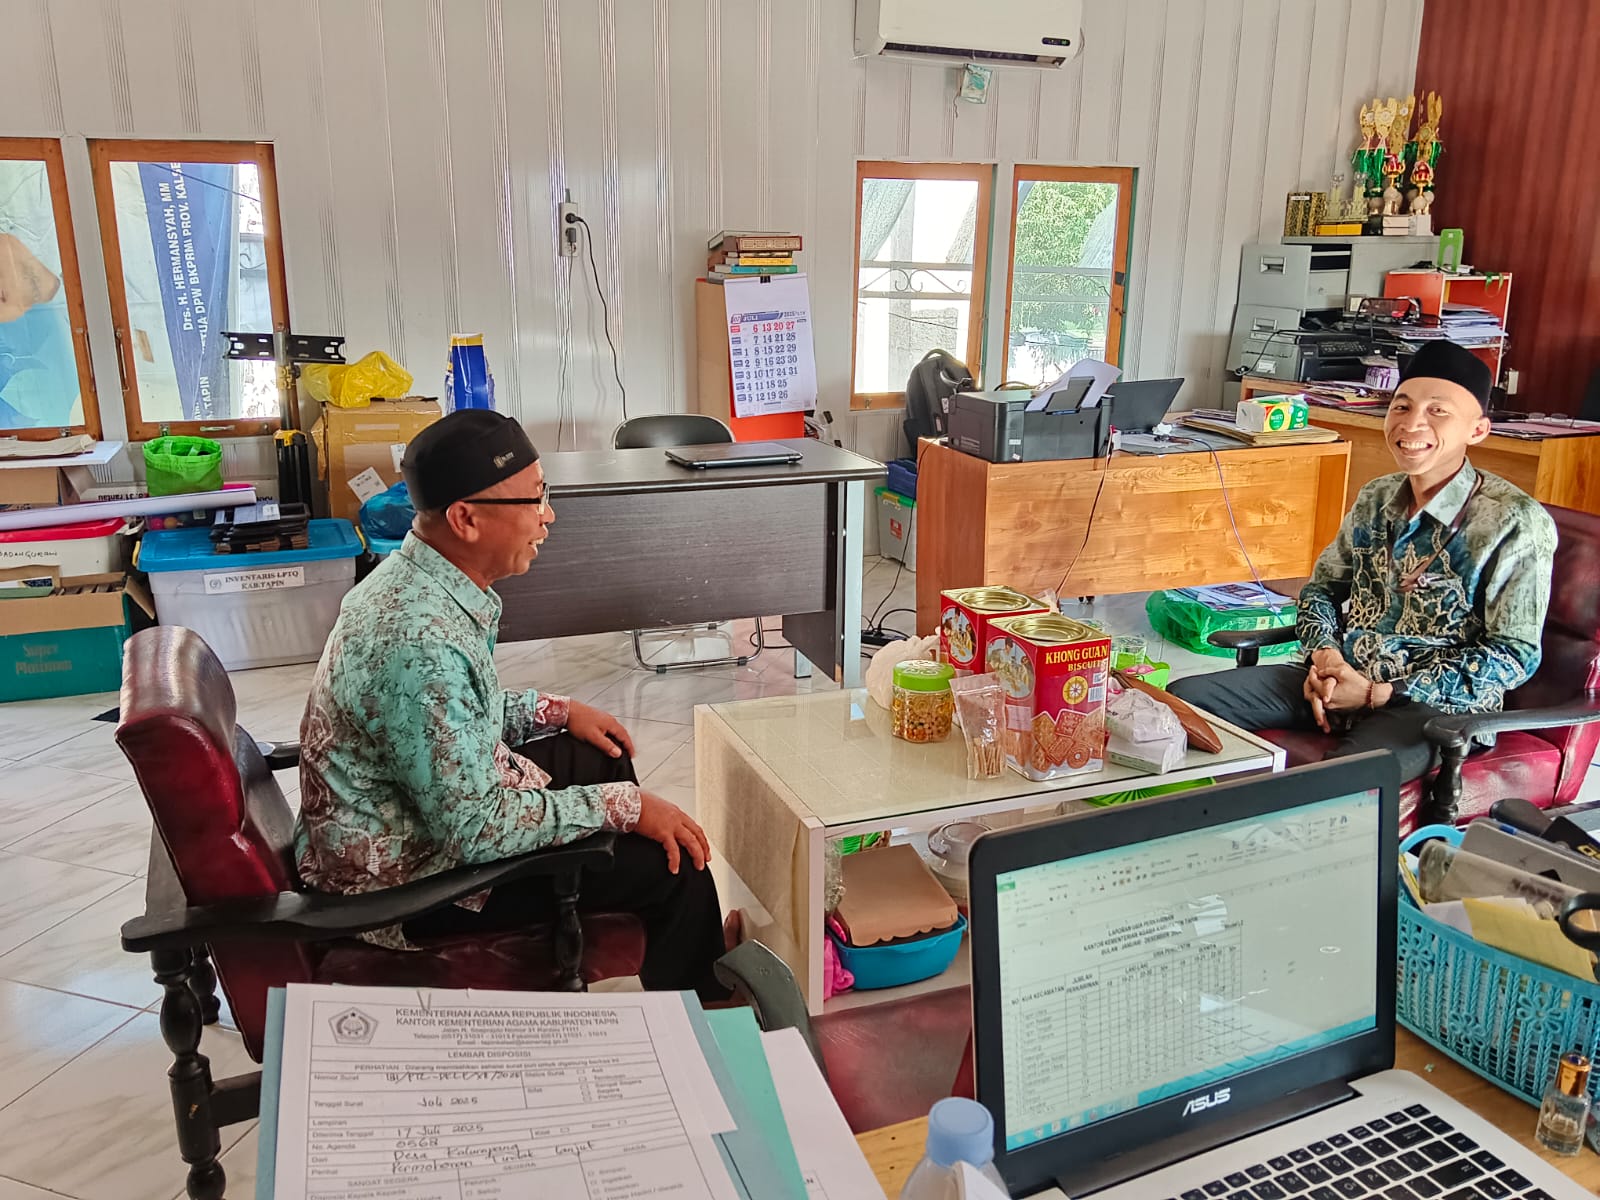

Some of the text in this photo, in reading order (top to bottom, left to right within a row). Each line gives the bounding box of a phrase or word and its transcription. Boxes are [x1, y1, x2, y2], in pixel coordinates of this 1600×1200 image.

[178, 202, 191, 237] PROV.
[158, 183, 194, 330] Drs. H. HERMANSYAH, MM
[184, 239, 199, 285] BKPRMI
[191, 288, 206, 314] DPW
[762, 323, 772, 332] 13
[774, 322, 784, 330] 20
[786, 320, 794, 330] 27
[763, 334, 772, 343] 14
[774, 333, 784, 342] 21
[786, 332, 796, 340] 28
[764, 346, 772, 354] 15
[775, 344, 784, 353] 22
[787, 344, 796, 352] 29
[764, 357, 774, 366] 16
[776, 356, 786, 364] 23
[788, 355, 798, 363] 30
[754, 370, 764, 378] 10
[766, 369, 774, 377] 17
[776, 368, 786, 376] 24
[788, 366, 798, 375] 31
[756, 382, 764, 390] 11
[766, 380, 776, 389] 18
[778, 379, 787, 388] 25
[756, 393, 764, 401] 12
[768, 392, 776, 400] 19
[778, 390, 788, 399] 26
[225, 570, 299, 583] INVENTARIS LPTQ
[1045, 645, 1108, 665] KHONG GUAN
[395, 1008, 617, 1018] KEMENTERIAN AGAMA REPUBLIK INDONESIA
[396, 1017, 619, 1027] KANTOR KEMENTERIAN AGAMA KABUPATEN TAPIN
[447, 1050, 532, 1059] LEMBAR DISPOSISI
[314, 1100, 342, 1108] Tanggal
[1182, 1087, 1231, 1117] ASUS
[397, 1123, 484, 1138] 17 Juli 2025
[347, 1179, 381, 1187] SANGAT
